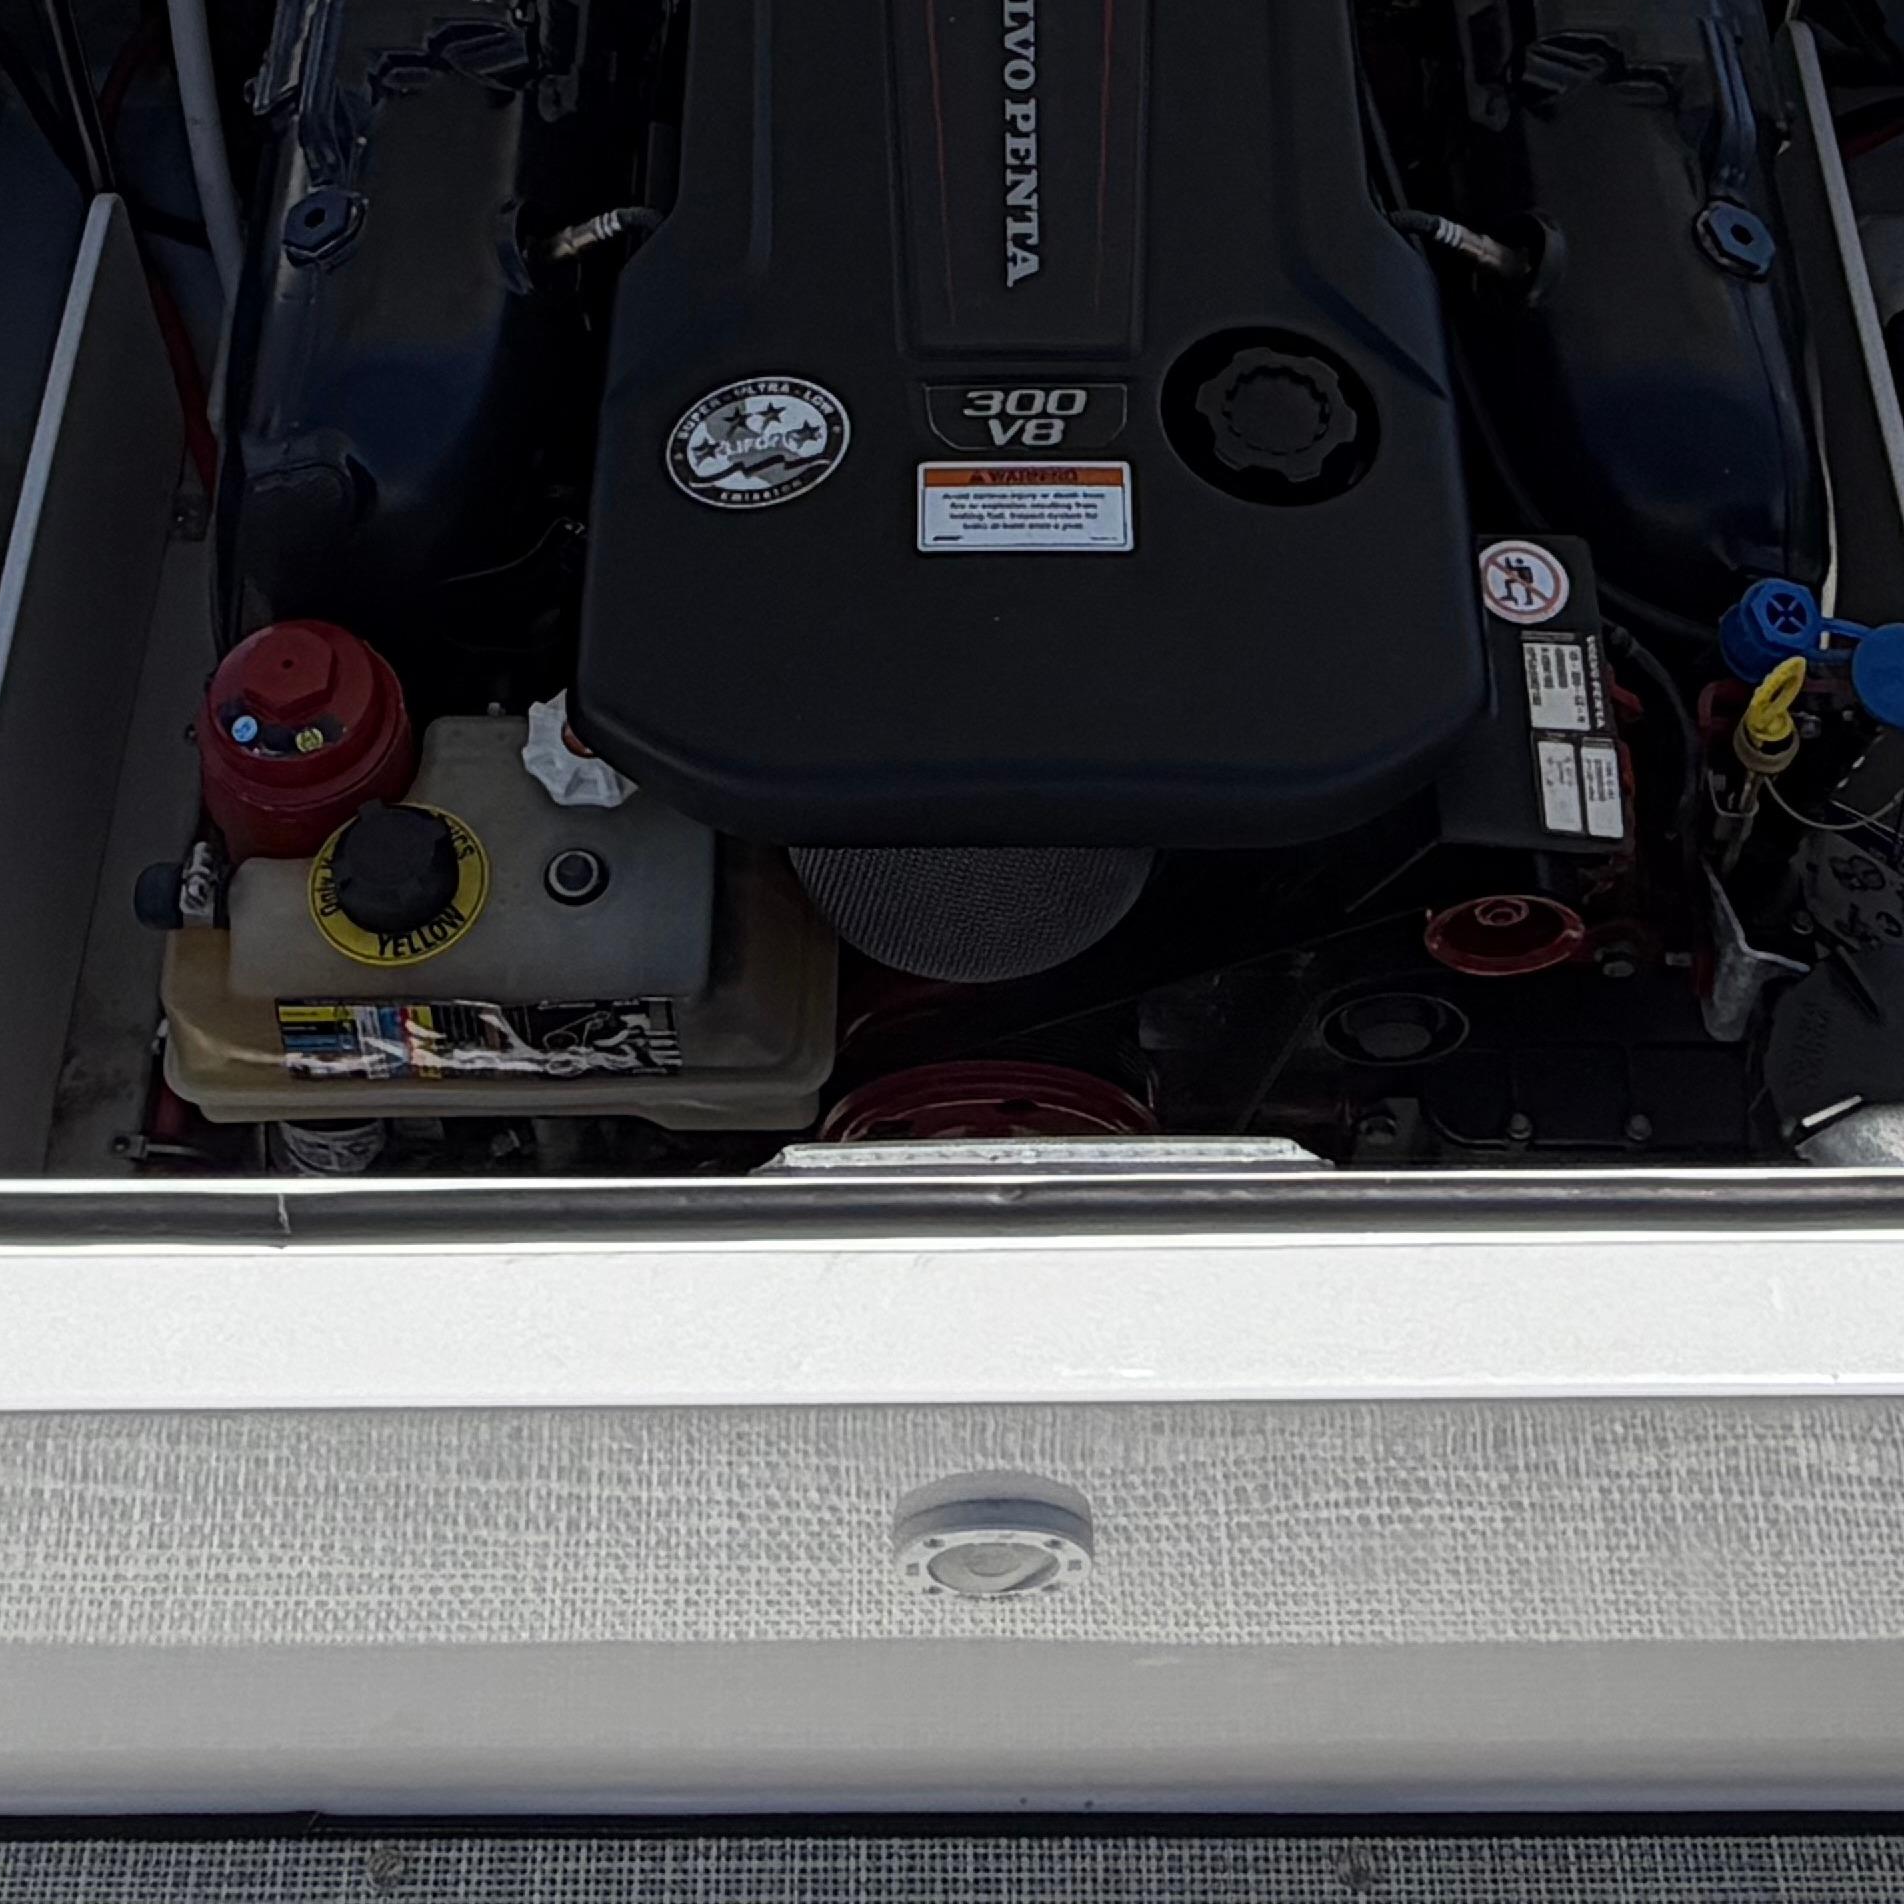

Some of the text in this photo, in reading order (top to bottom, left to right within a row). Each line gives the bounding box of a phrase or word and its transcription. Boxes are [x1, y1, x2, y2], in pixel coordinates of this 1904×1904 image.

[1004, 97, 1040, 288] PENTA
[732, 380, 791, 398] ULTRA
[803, 388, 835, 415] LOW
[962, 388, 1089, 417] 300
[987, 417, 1066, 447] V8
[377, 904, 465, 957] YELLOW
